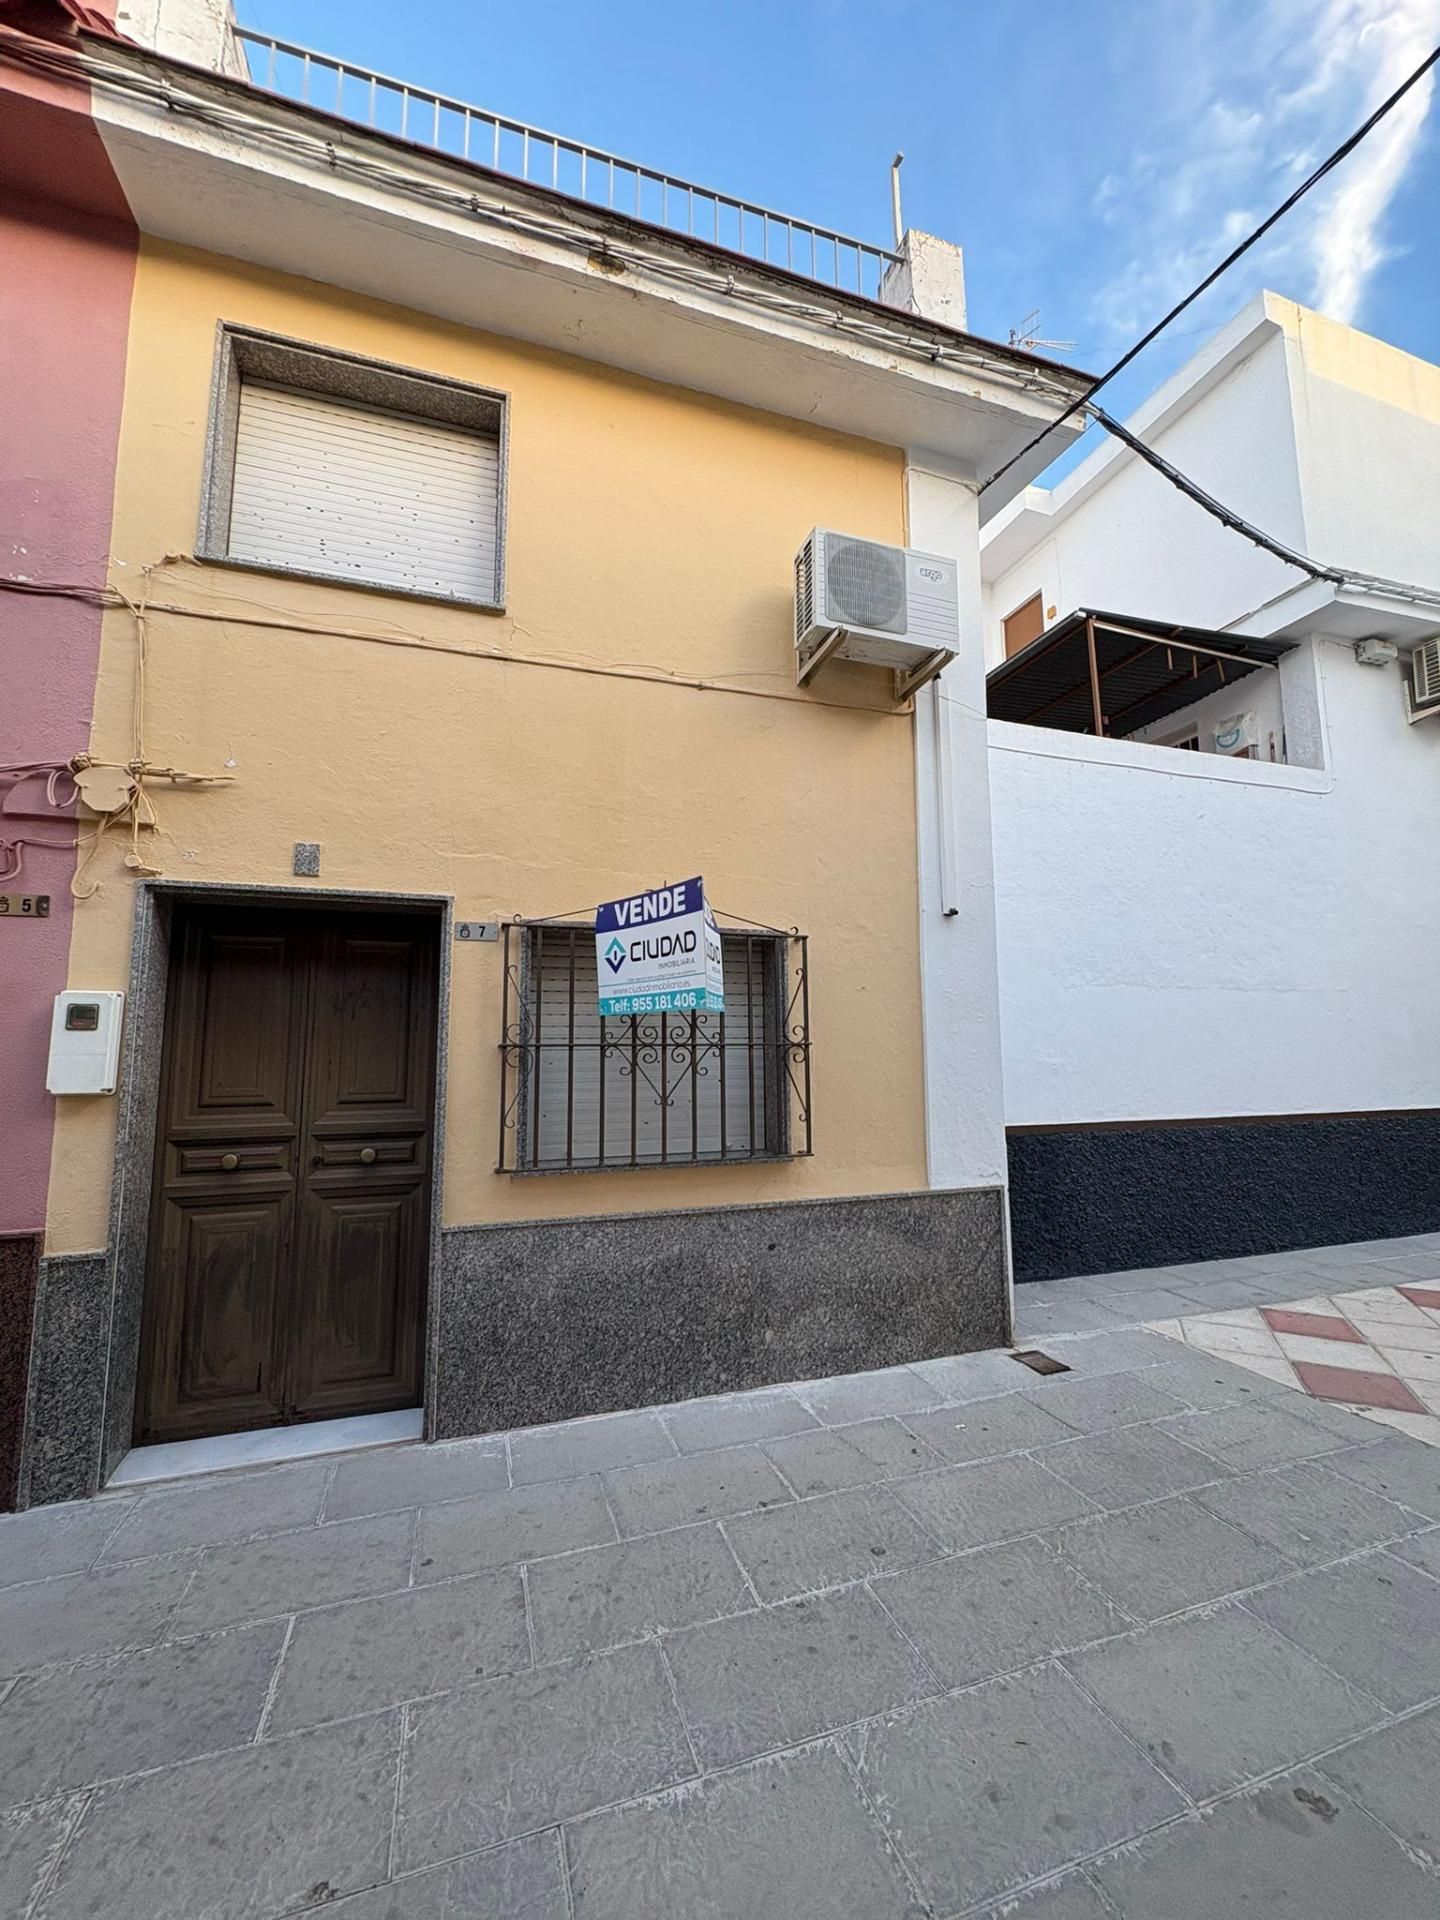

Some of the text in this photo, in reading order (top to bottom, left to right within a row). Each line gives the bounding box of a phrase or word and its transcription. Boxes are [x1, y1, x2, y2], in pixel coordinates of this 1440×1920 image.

[22, 898, 31, 912] 5
[614, 885, 686, 926] VENDE
[478, 925, 486, 938] 7
[630, 930, 697, 962] CIUDAD
[608, 999, 631, 1013] Telf:
[632, 996, 653, 1011] 955
[654, 994, 673, 1010] 181
[673, 991, 697, 1007] 406
